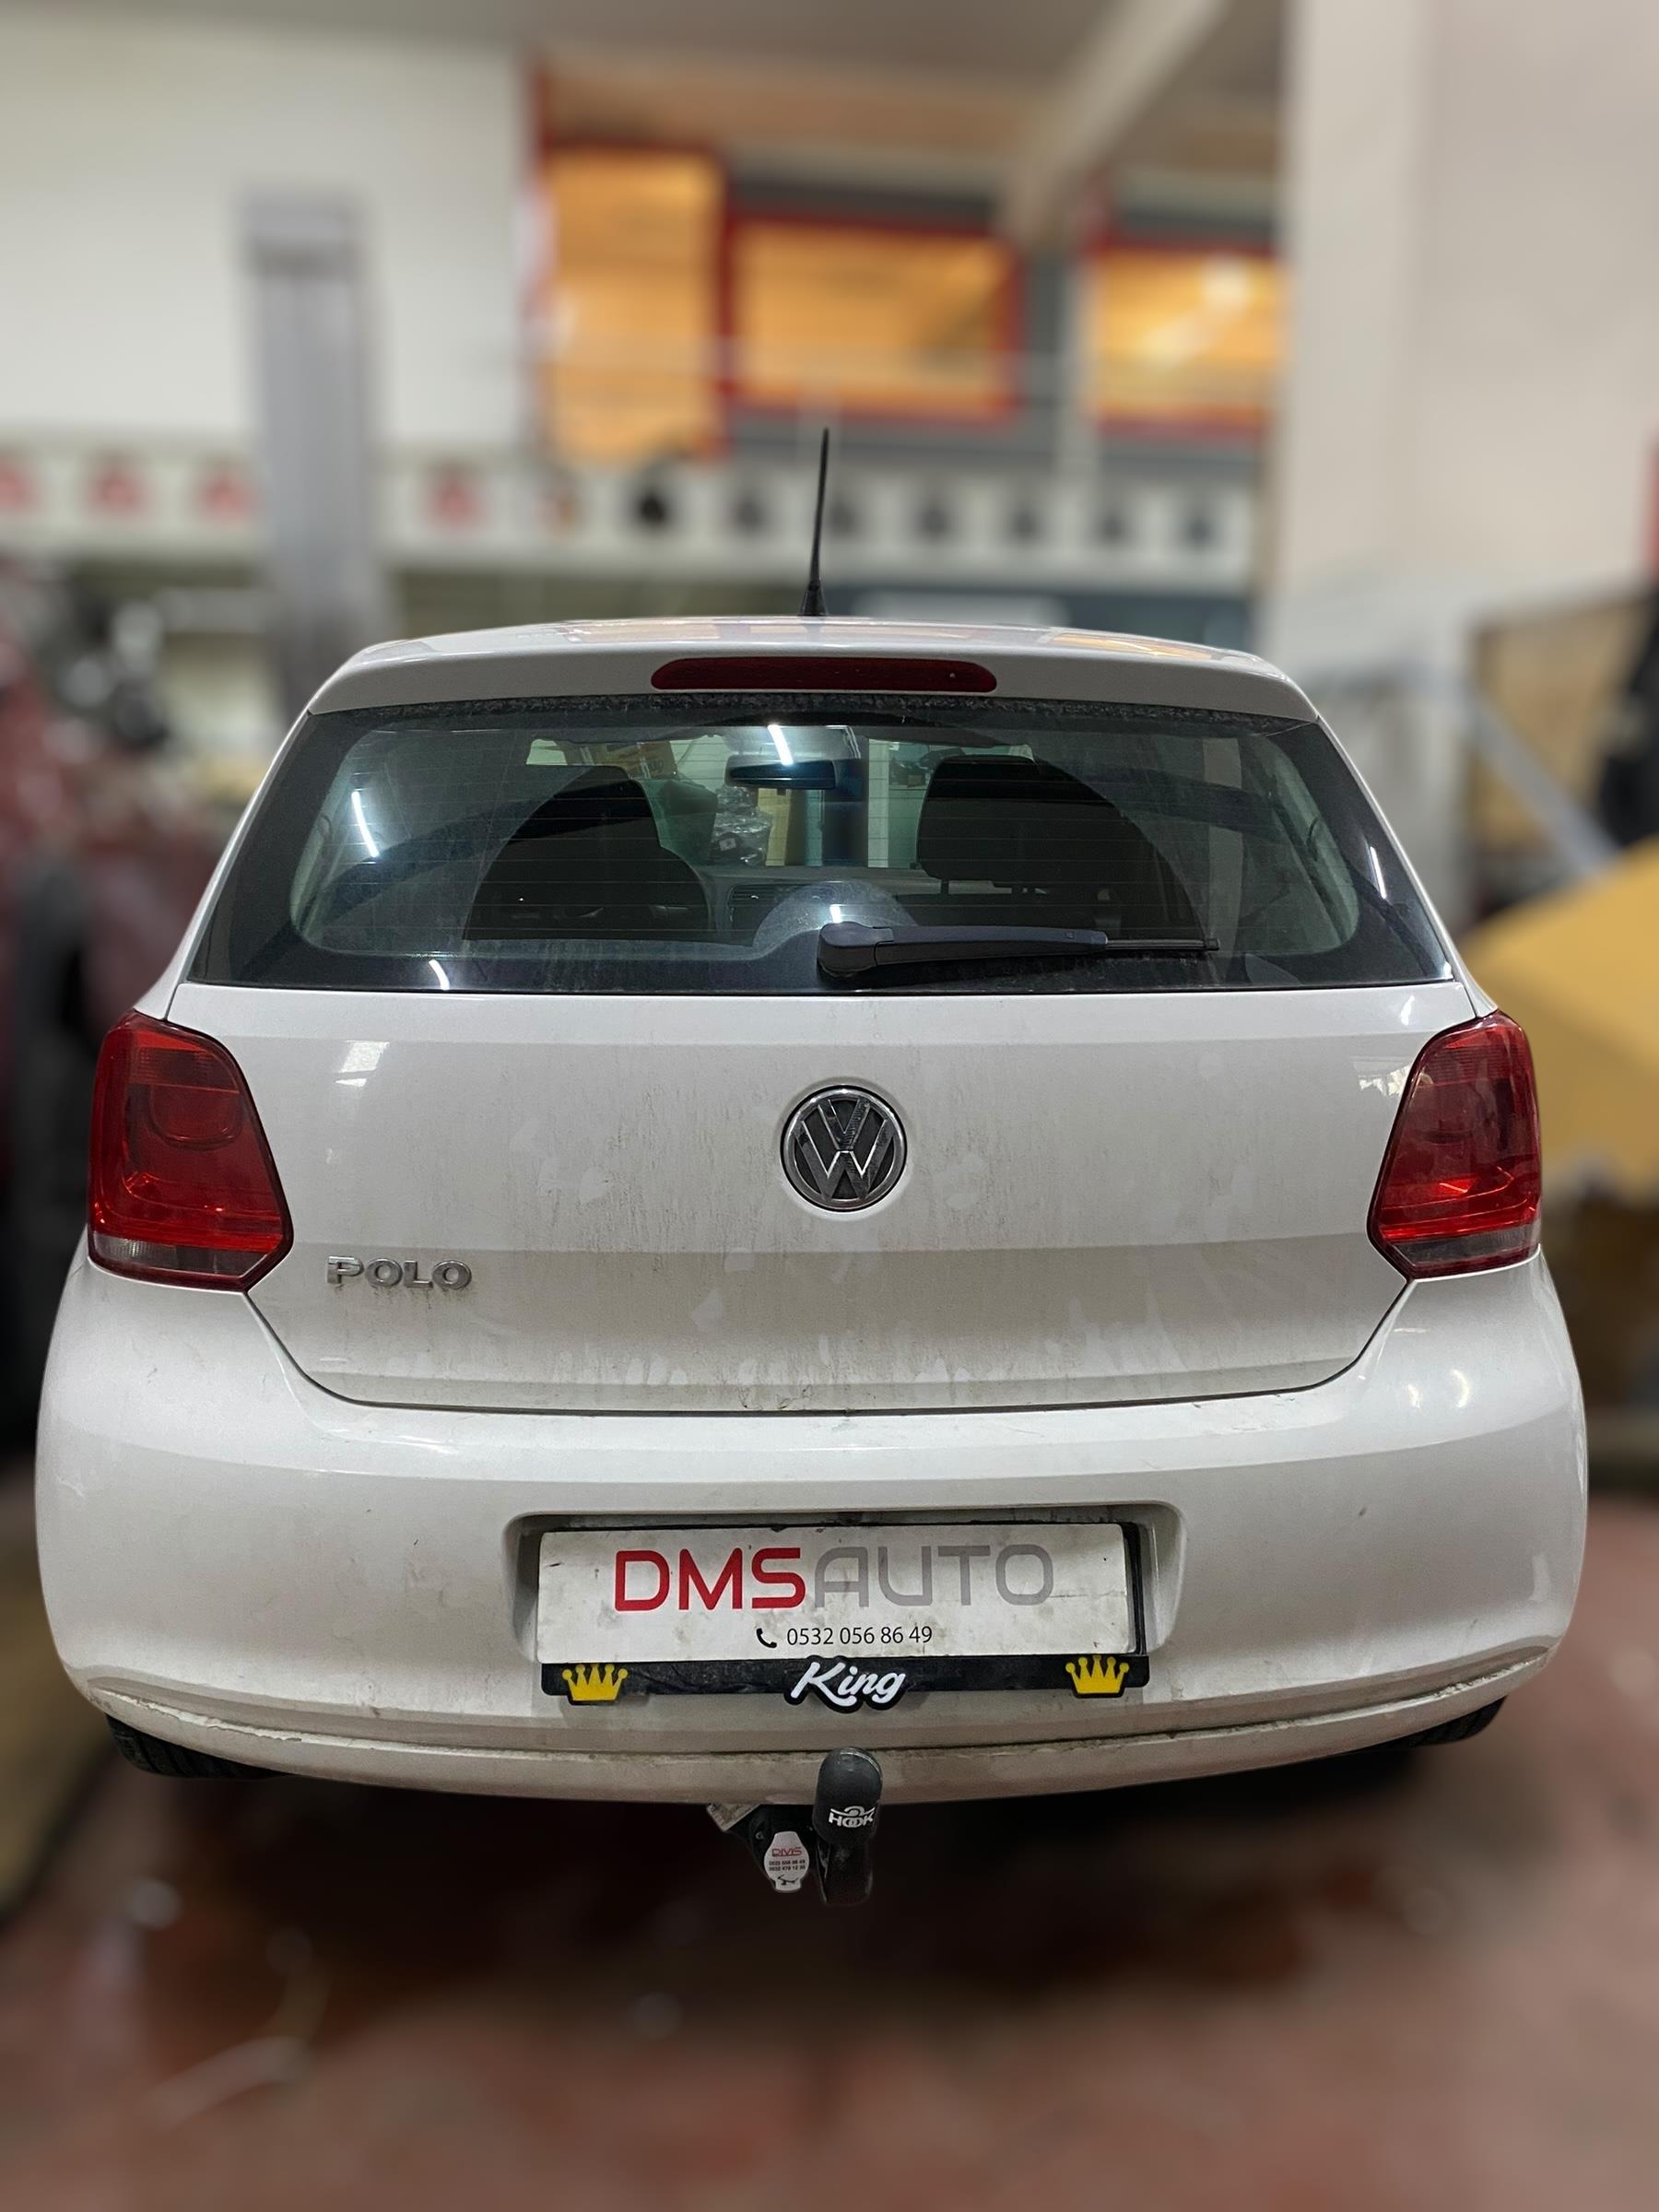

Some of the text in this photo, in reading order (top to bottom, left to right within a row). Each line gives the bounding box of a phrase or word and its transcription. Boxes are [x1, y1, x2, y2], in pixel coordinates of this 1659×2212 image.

[327, 1255, 472, 1290] POLO
[787, 1625, 933, 1645] 0532 056 86 49
[791, 1662, 906, 1707] King
[829, 1811, 875, 1828] HOOK
[771, 1846, 802, 1857] DMS
